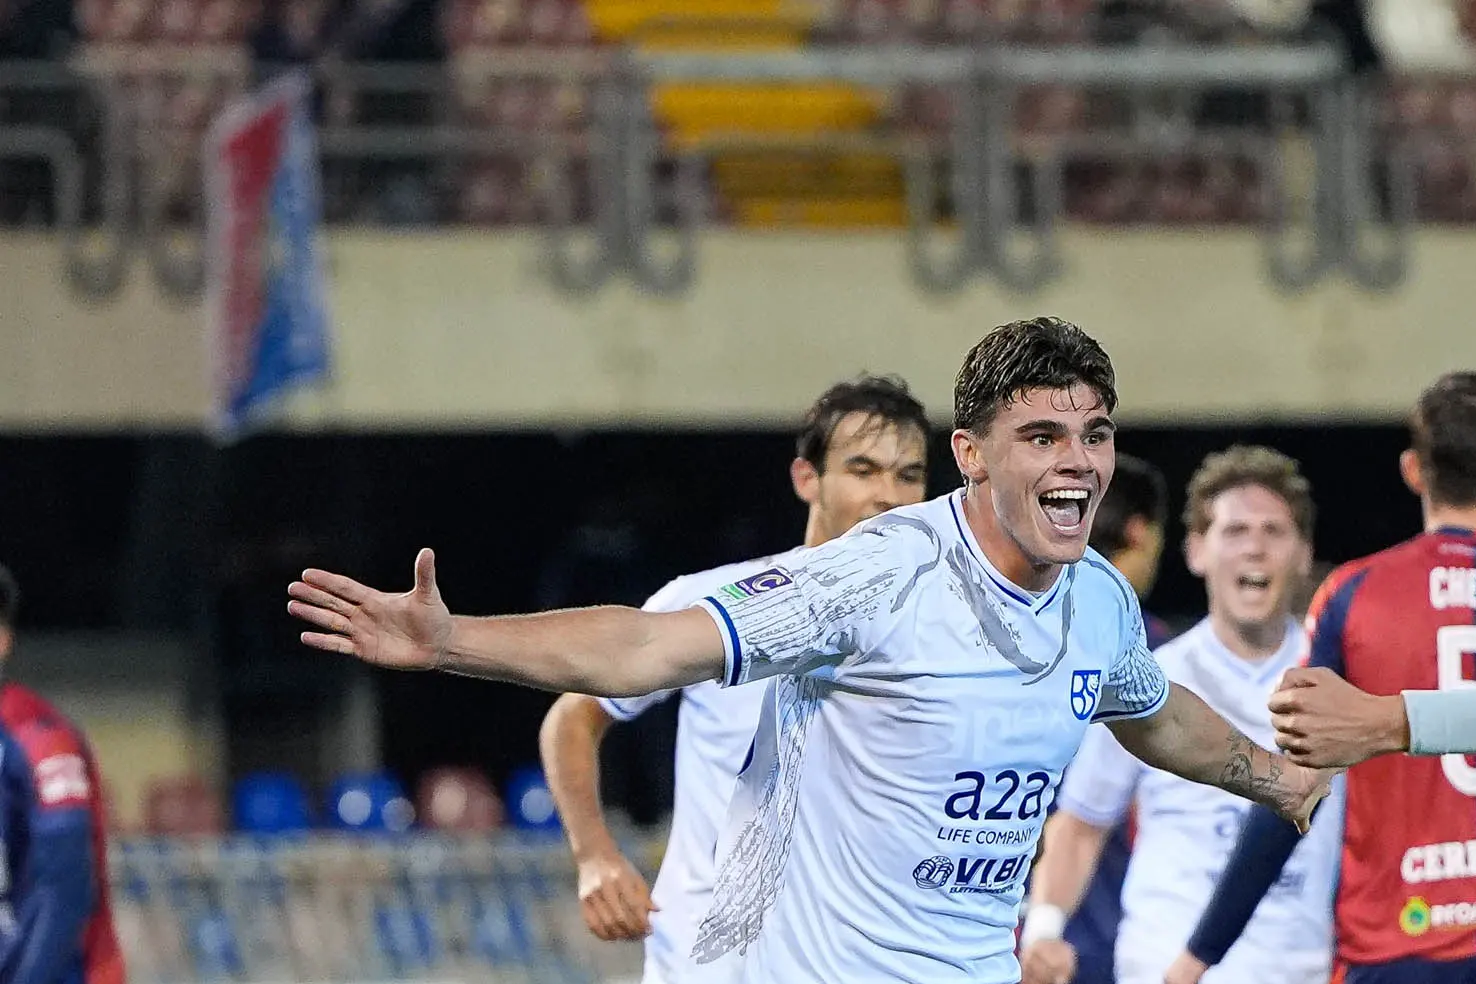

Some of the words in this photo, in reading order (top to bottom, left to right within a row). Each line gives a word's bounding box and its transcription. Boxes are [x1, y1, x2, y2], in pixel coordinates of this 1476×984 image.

[944, 770, 1050, 821] a2a
[937, 826, 971, 843] LIFE
[975, 827, 1035, 845] COMPANY
